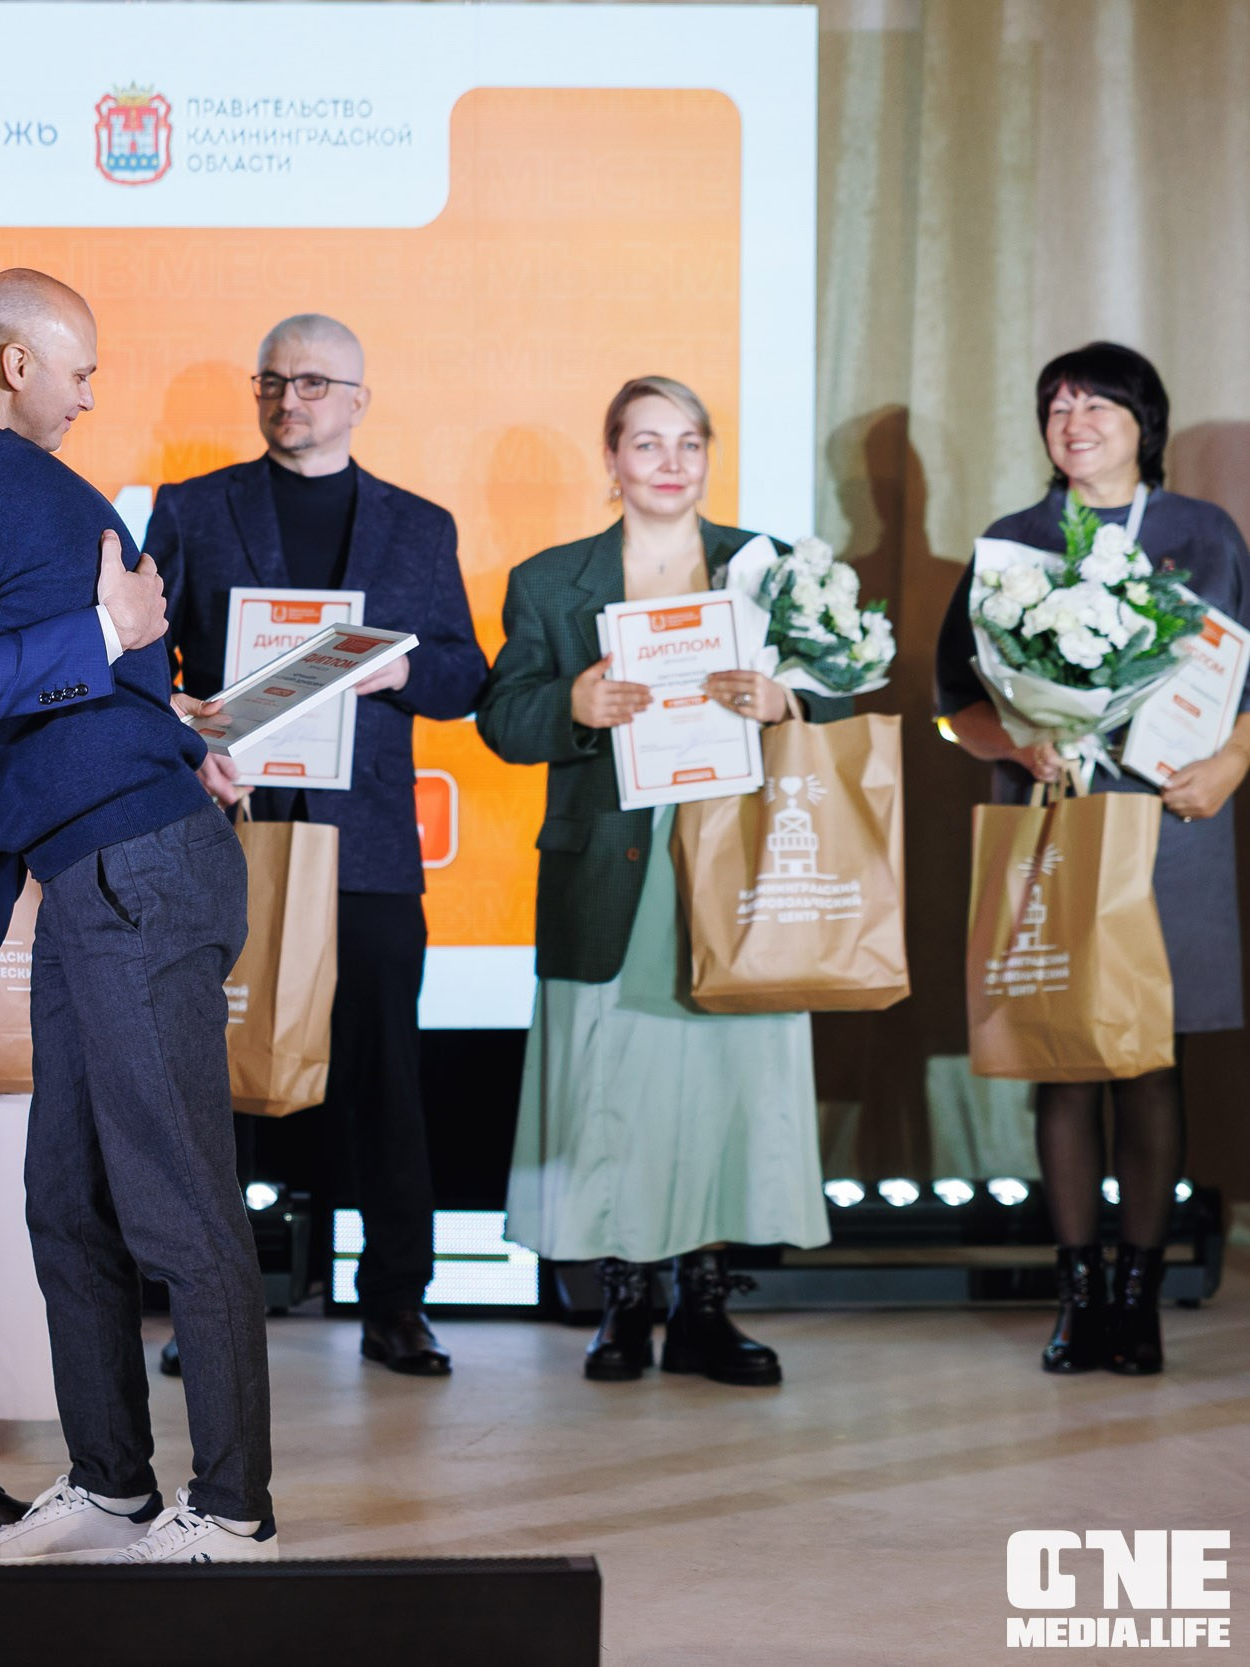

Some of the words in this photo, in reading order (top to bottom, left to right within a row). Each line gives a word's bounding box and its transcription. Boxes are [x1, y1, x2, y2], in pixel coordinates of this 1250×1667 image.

[186, 97, 374, 119] ПРАВИТЕЛЬСТВО
[186, 121, 413, 147] КАЛИНИНГРАДСКОЙ
[186, 153, 292, 173] ОБЛАСТИ
[638, 636, 721, 660] ДИПЛОМ
[302, 653, 360, 669] ДИПЛОМ
